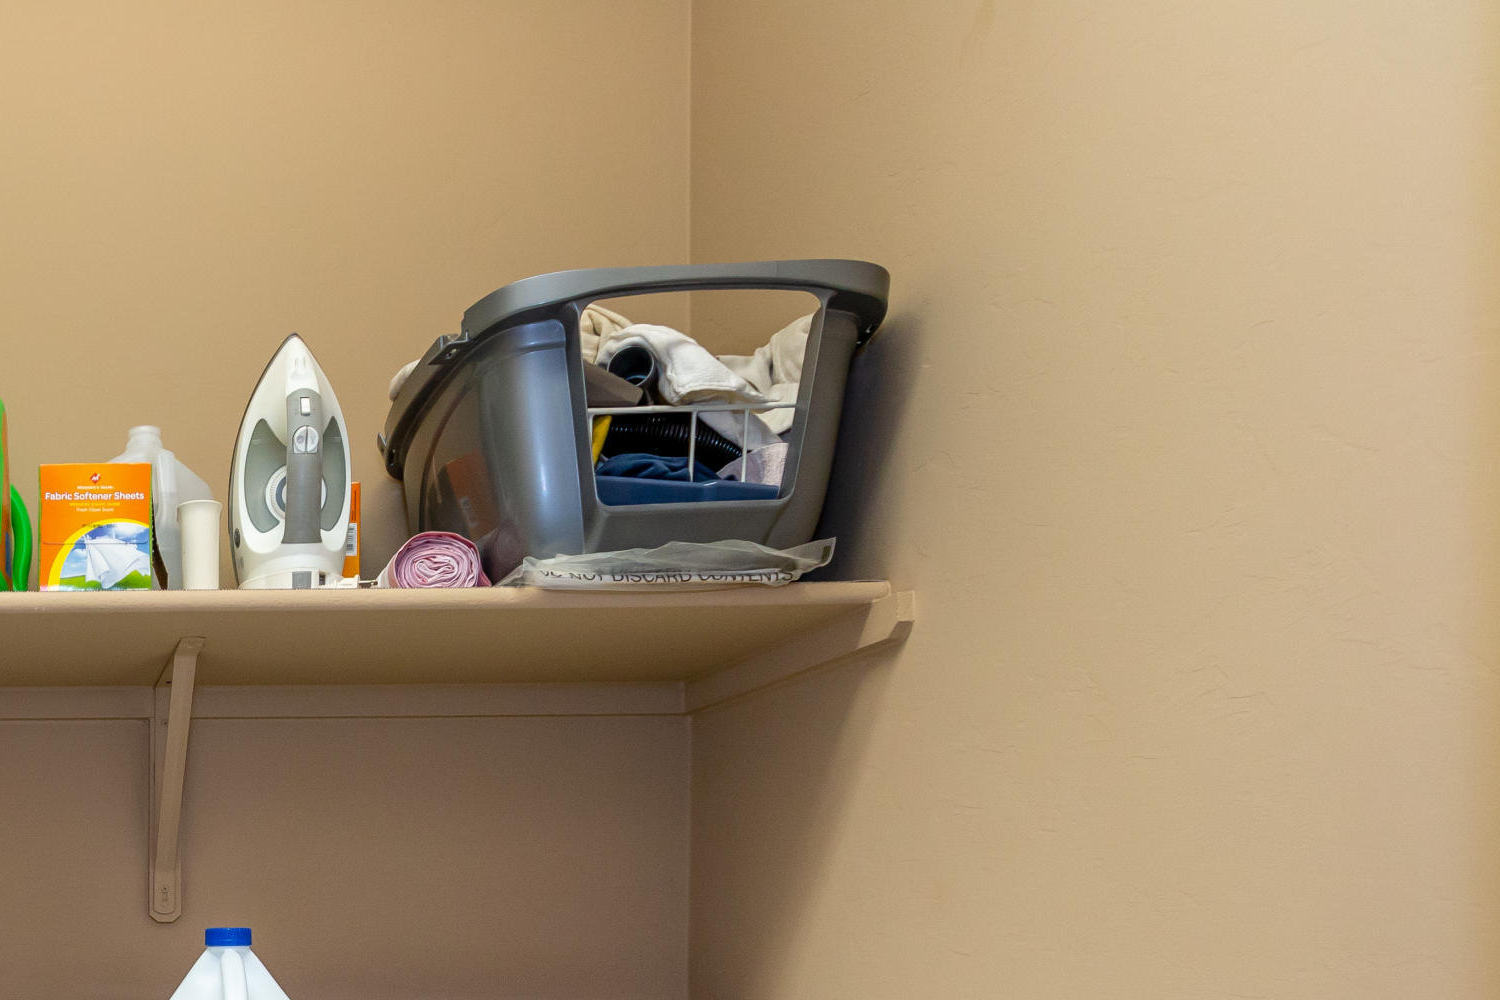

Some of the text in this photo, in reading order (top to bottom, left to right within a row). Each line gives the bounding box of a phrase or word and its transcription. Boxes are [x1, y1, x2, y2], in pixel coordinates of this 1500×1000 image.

[45, 491, 145, 500] Fabric Softener Sheets
